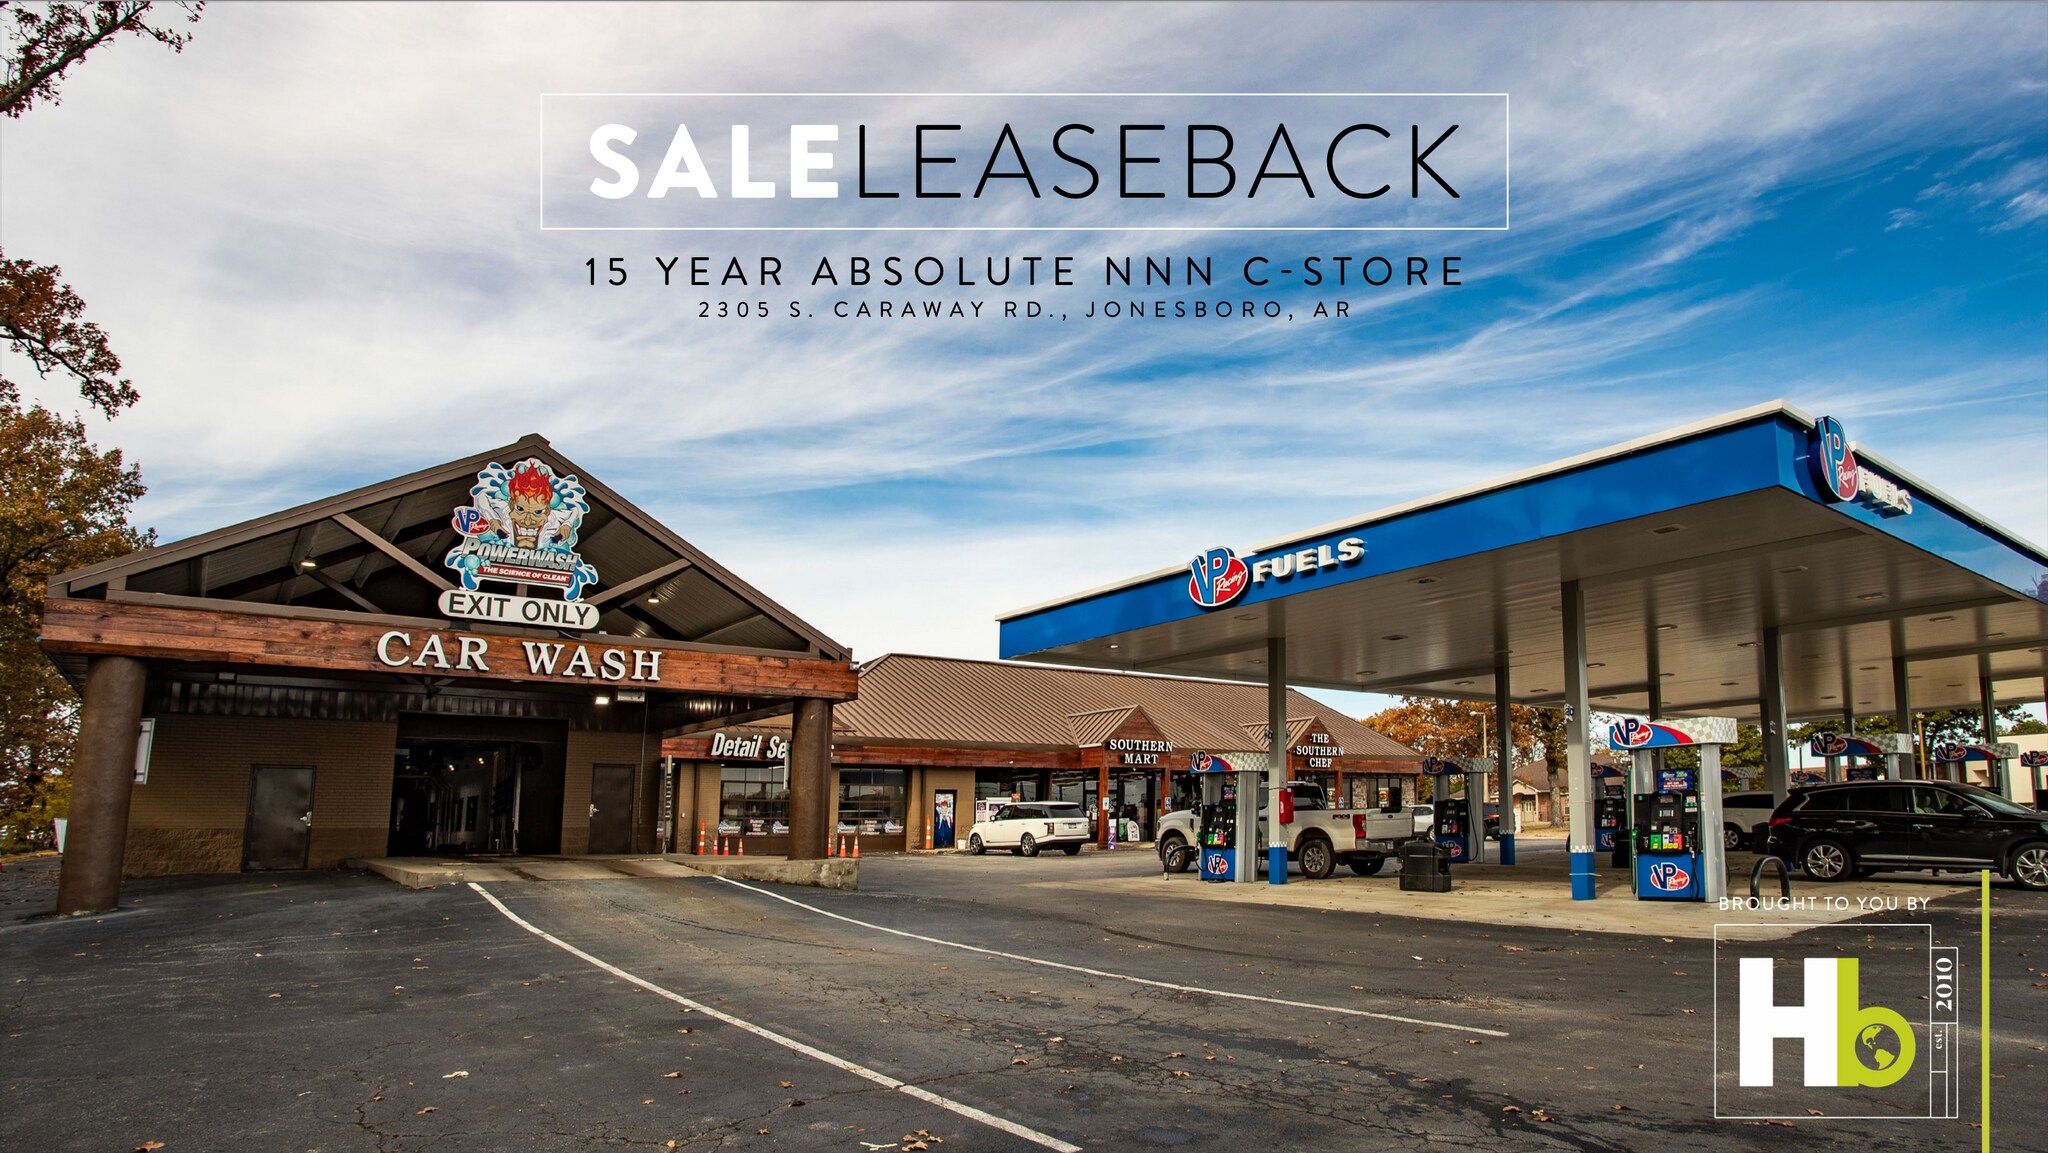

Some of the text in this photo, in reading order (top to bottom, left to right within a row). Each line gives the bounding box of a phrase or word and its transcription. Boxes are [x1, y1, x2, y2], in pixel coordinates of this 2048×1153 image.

[1817, 416, 1846, 495] VP
[457, 509, 480, 533] VP
[483, 566, 499, 575] THE
[498, 567, 531, 578] SCIENCE
[1252, 537, 1367, 583] FUELS
[1190, 547, 1231, 605] VP
[1216, 569, 1247, 597] Racing
[449, 592, 591, 626] EXIT ONLY
[376, 631, 663, 682] CAR WASH
[1311, 733, 1330, 744] THE
[1614, 718, 1640, 746] VP
[1814, 733, 1837, 754] VP
[710, 732, 763, 759] Detail
[1109, 738, 1174, 753] SOUTHERN
[1295, 745, 1345, 756] SOUTHERN
[1937, 743, 1957, 760] VP
[1124, 753, 1159, 765] MART
[1192, 750, 1206, 771] VP
[1309, 757, 1333, 768] CHEF
[1652, 863, 1677, 890] VP
